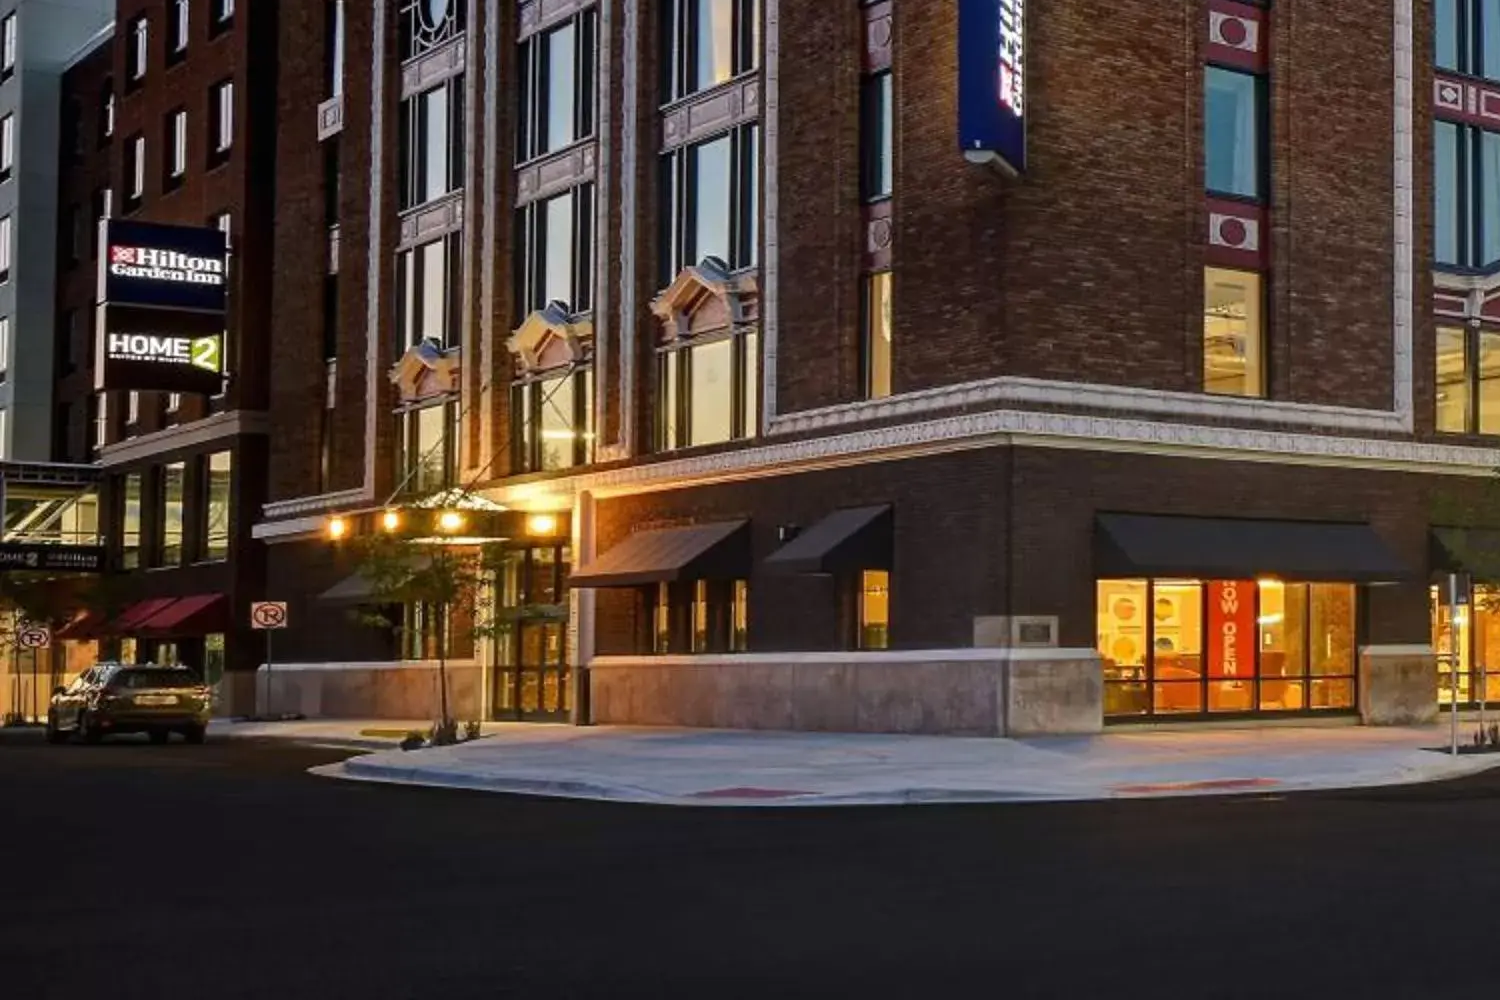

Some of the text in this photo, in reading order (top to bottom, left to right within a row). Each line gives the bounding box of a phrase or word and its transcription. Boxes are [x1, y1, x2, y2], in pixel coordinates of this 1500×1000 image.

[136, 247, 222, 272] Hilton
[111, 263, 221, 285] Garden Inn
[1223, 622, 1237, 676] OPEN
